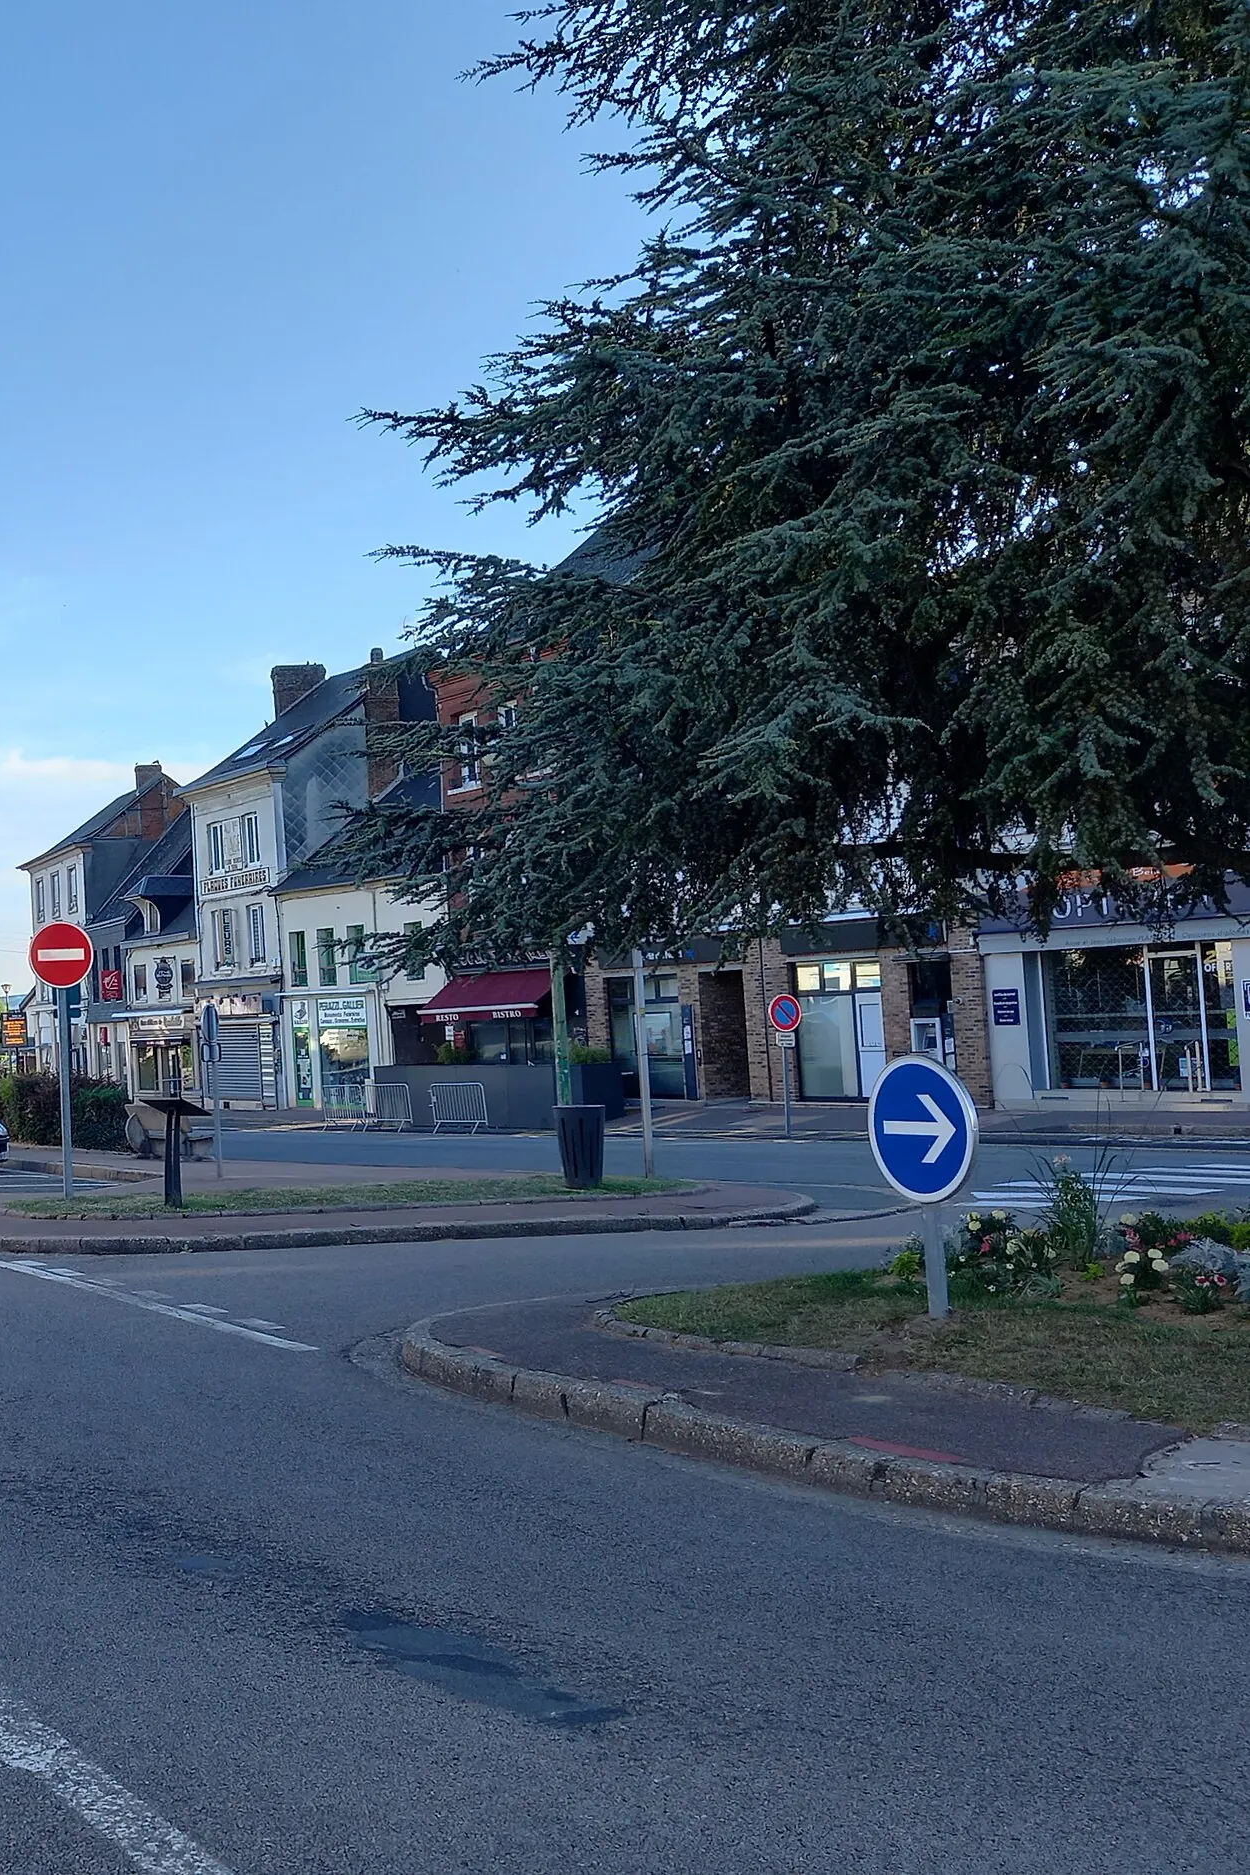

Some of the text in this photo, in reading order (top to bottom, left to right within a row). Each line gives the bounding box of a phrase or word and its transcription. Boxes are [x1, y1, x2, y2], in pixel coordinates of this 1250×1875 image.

[222, 910, 232, 955] FLEURS
[435, 1010, 522, 1022] RESTO BISTRO
